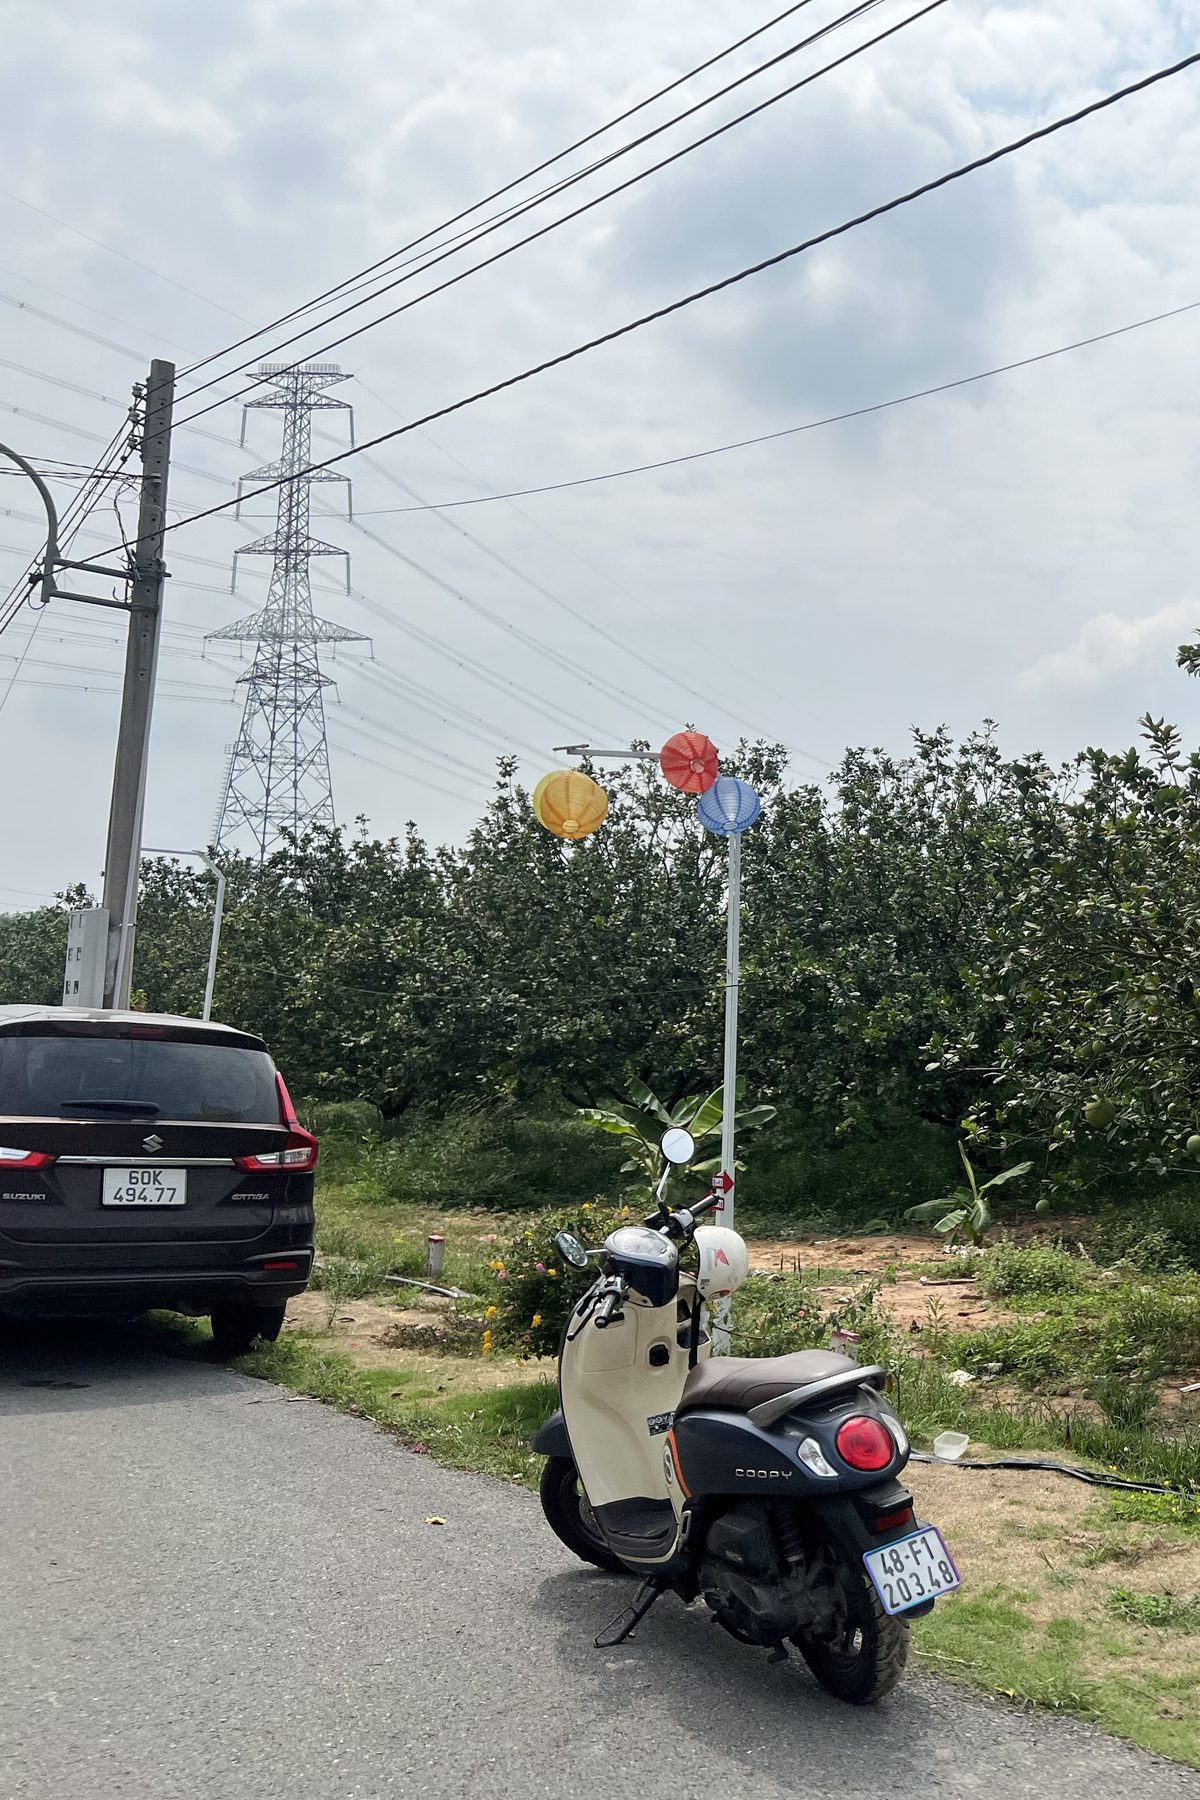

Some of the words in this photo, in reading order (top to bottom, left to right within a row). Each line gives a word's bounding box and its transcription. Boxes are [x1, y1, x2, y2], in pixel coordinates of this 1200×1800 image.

[129, 1170, 163, 1185] 60K
[113, 1187, 177, 1203] 494.77
[880, 1536, 934, 1576] 48-F1
[883, 1560, 954, 1609] 203.48
